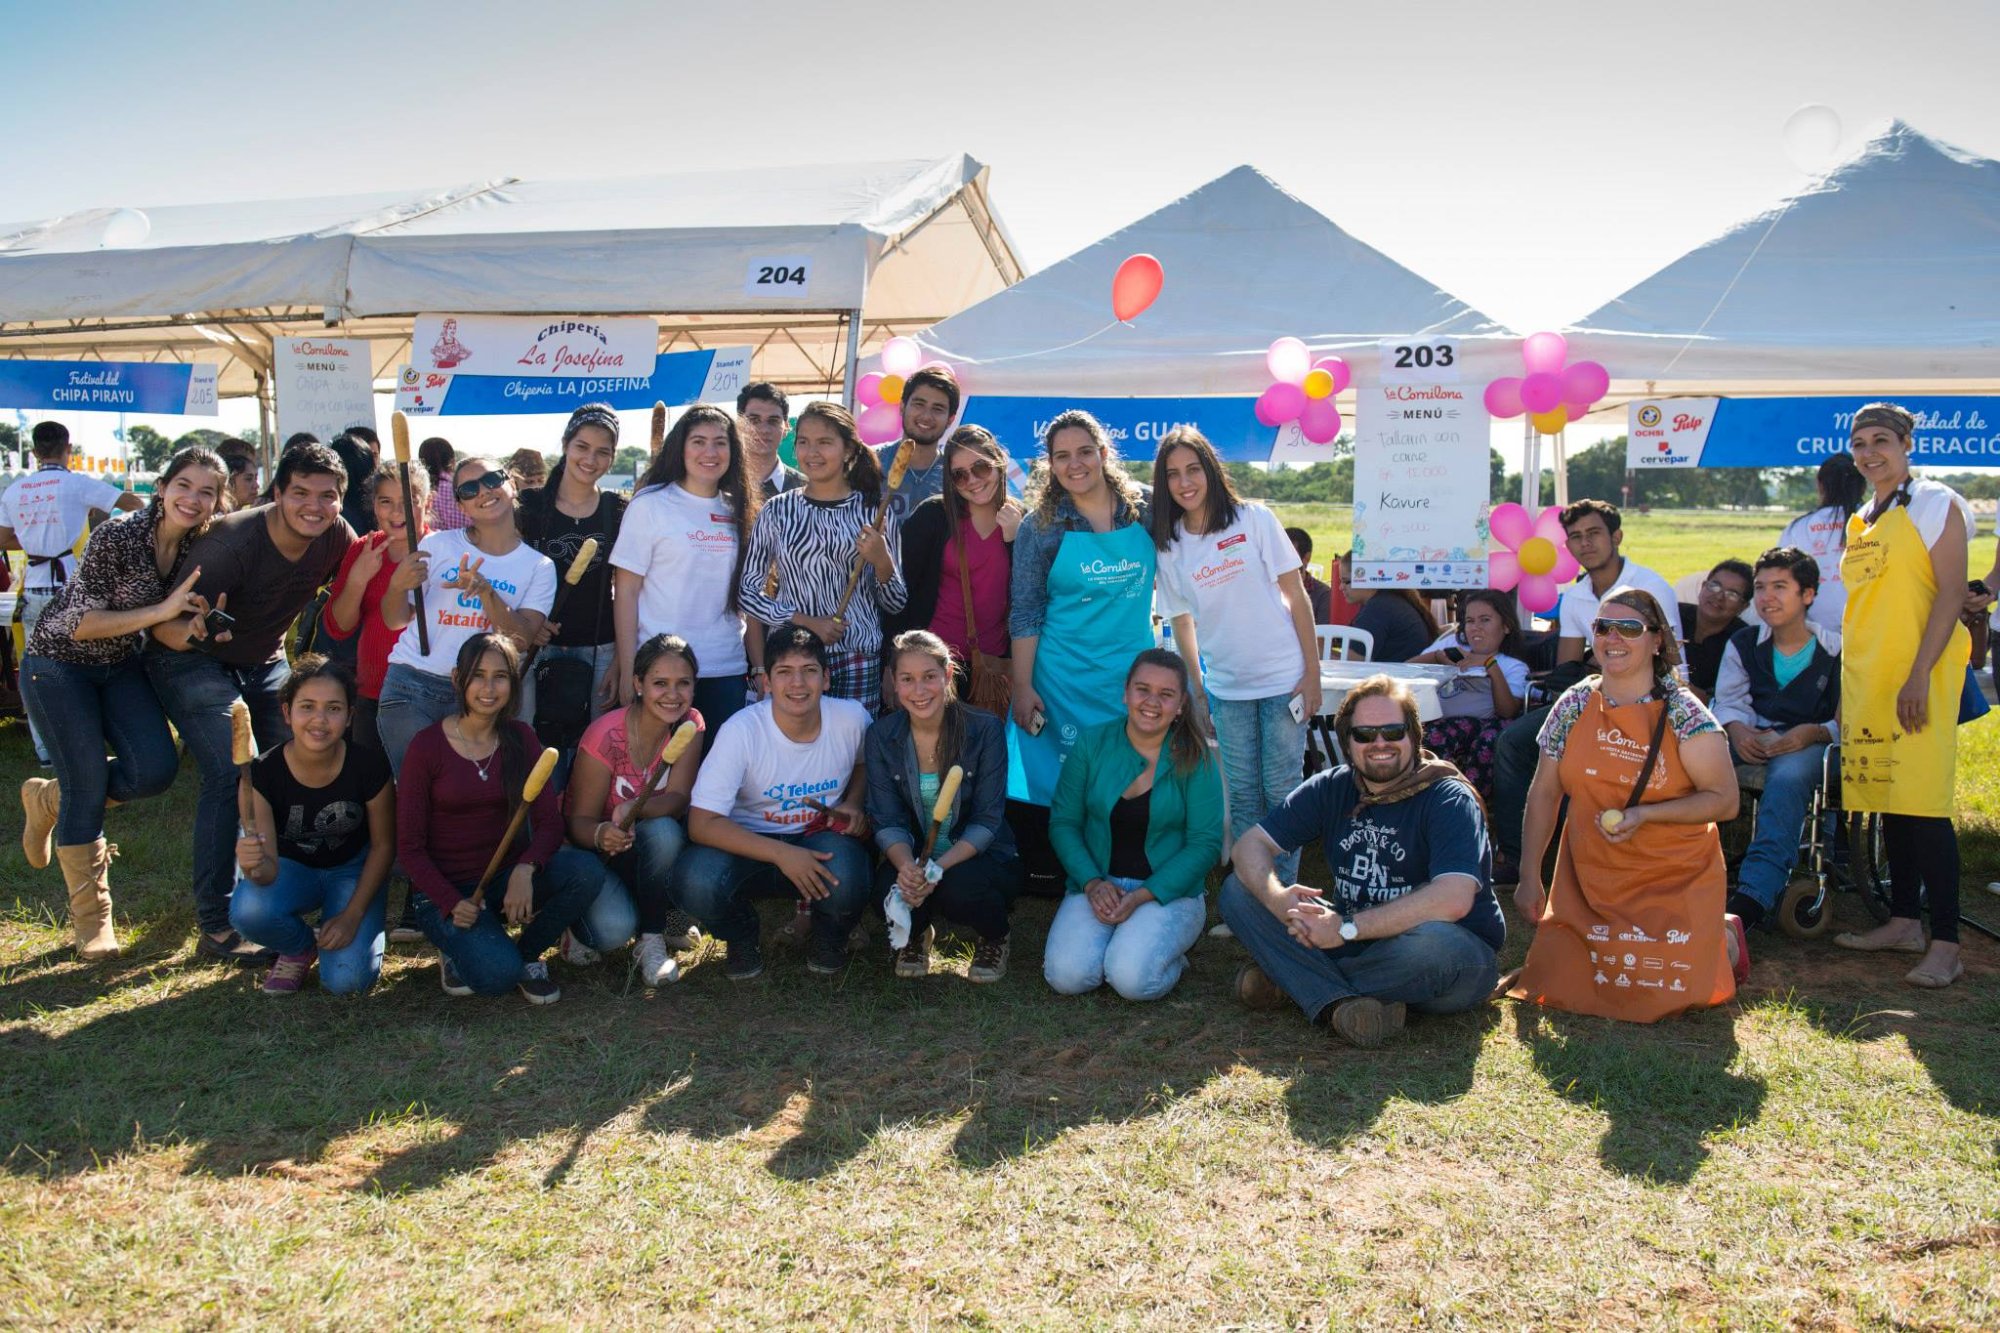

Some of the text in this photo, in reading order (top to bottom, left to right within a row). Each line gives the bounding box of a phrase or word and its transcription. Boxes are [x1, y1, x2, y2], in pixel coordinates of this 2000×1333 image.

[756, 266, 806, 285] 204
[517, 344, 625, 374] La Josefina
[715, 360, 735, 368] Stand
[1394, 345, 1454, 368] 203
[306, 361, 336, 371] MENÚ
[68, 371, 120, 386] Festival del
[557, 380, 577, 395] LA
[578, 377, 651, 398] JOSEFINA
[711, 372, 739, 392] 204
[52, 388, 135, 404] CHIPA PIRAYU
[1397, 385, 1464, 401] Comilona
[1403, 407, 1443, 419] MENÚ
[1965, 410, 1988, 430] de
[1672, 413, 1703, 433] Pulp
[1640, 455, 1690, 465] cervepar
[1091, 558, 1142, 574] Comilona
[787, 779, 838, 797] Teletón
[1379, 835, 1390, 849] &
[1390, 842, 1406, 861] CO
[1335, 876, 1362, 901] NEW
[1666, 929, 1691, 944] Pulp
